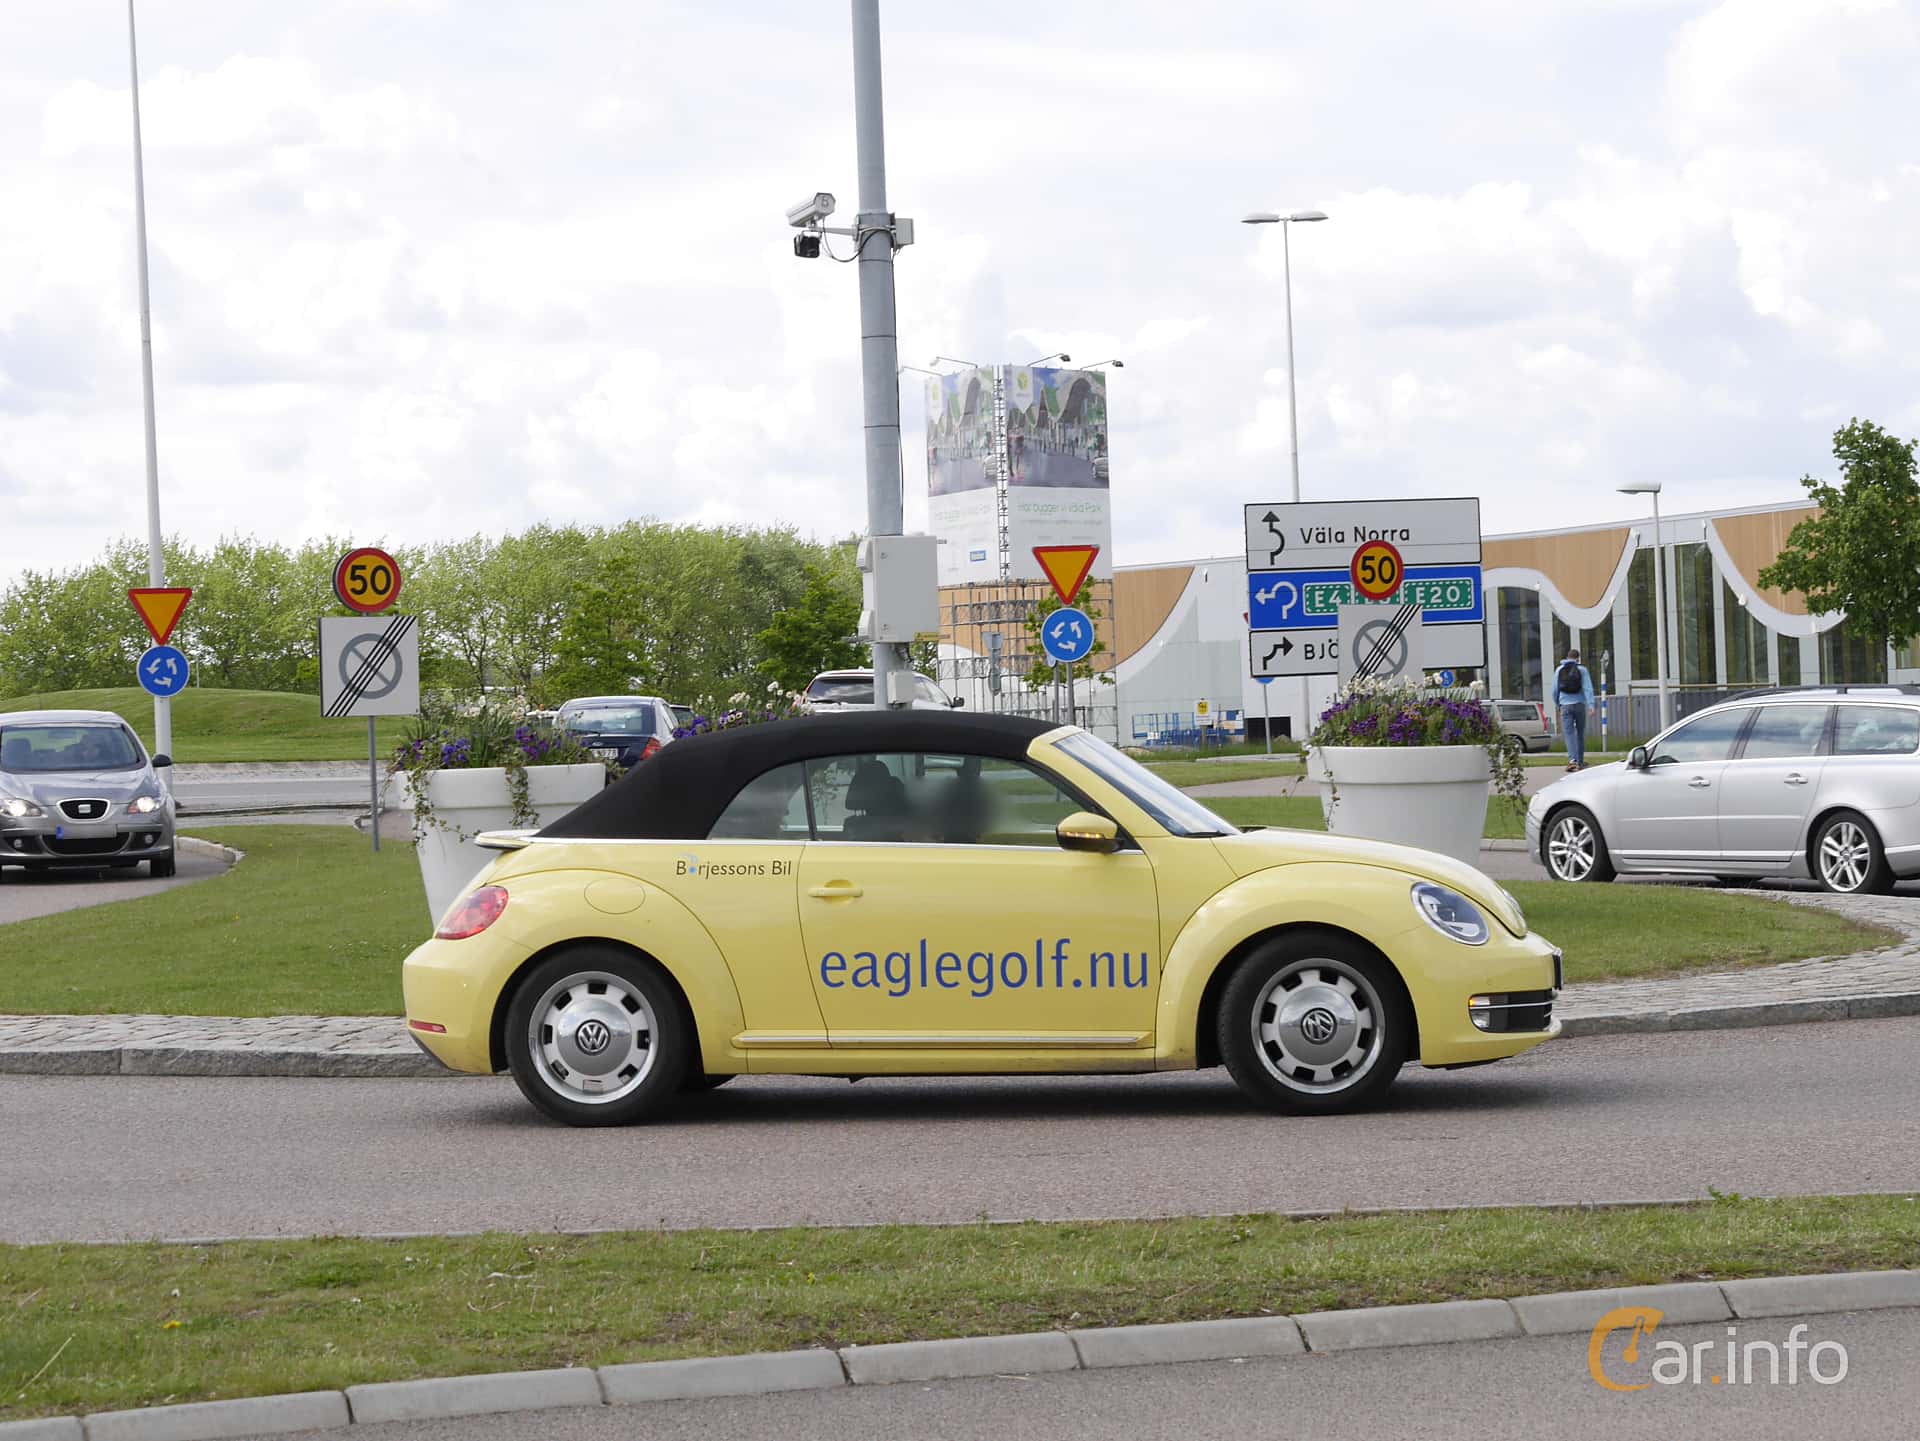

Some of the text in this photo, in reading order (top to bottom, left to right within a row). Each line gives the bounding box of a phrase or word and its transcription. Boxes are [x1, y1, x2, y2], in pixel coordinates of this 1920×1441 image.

[1300, 526, 1410, 544] Väla Norra
[1360, 555, 1396, 584] 50
[349, 564, 391, 596] 50
[1314, 589, 1342, 608] E4
[1415, 585, 1460, 604] E20
[771, 859, 792, 876] Bil
[820, 938, 1149, 998] eaglegolf.nu
